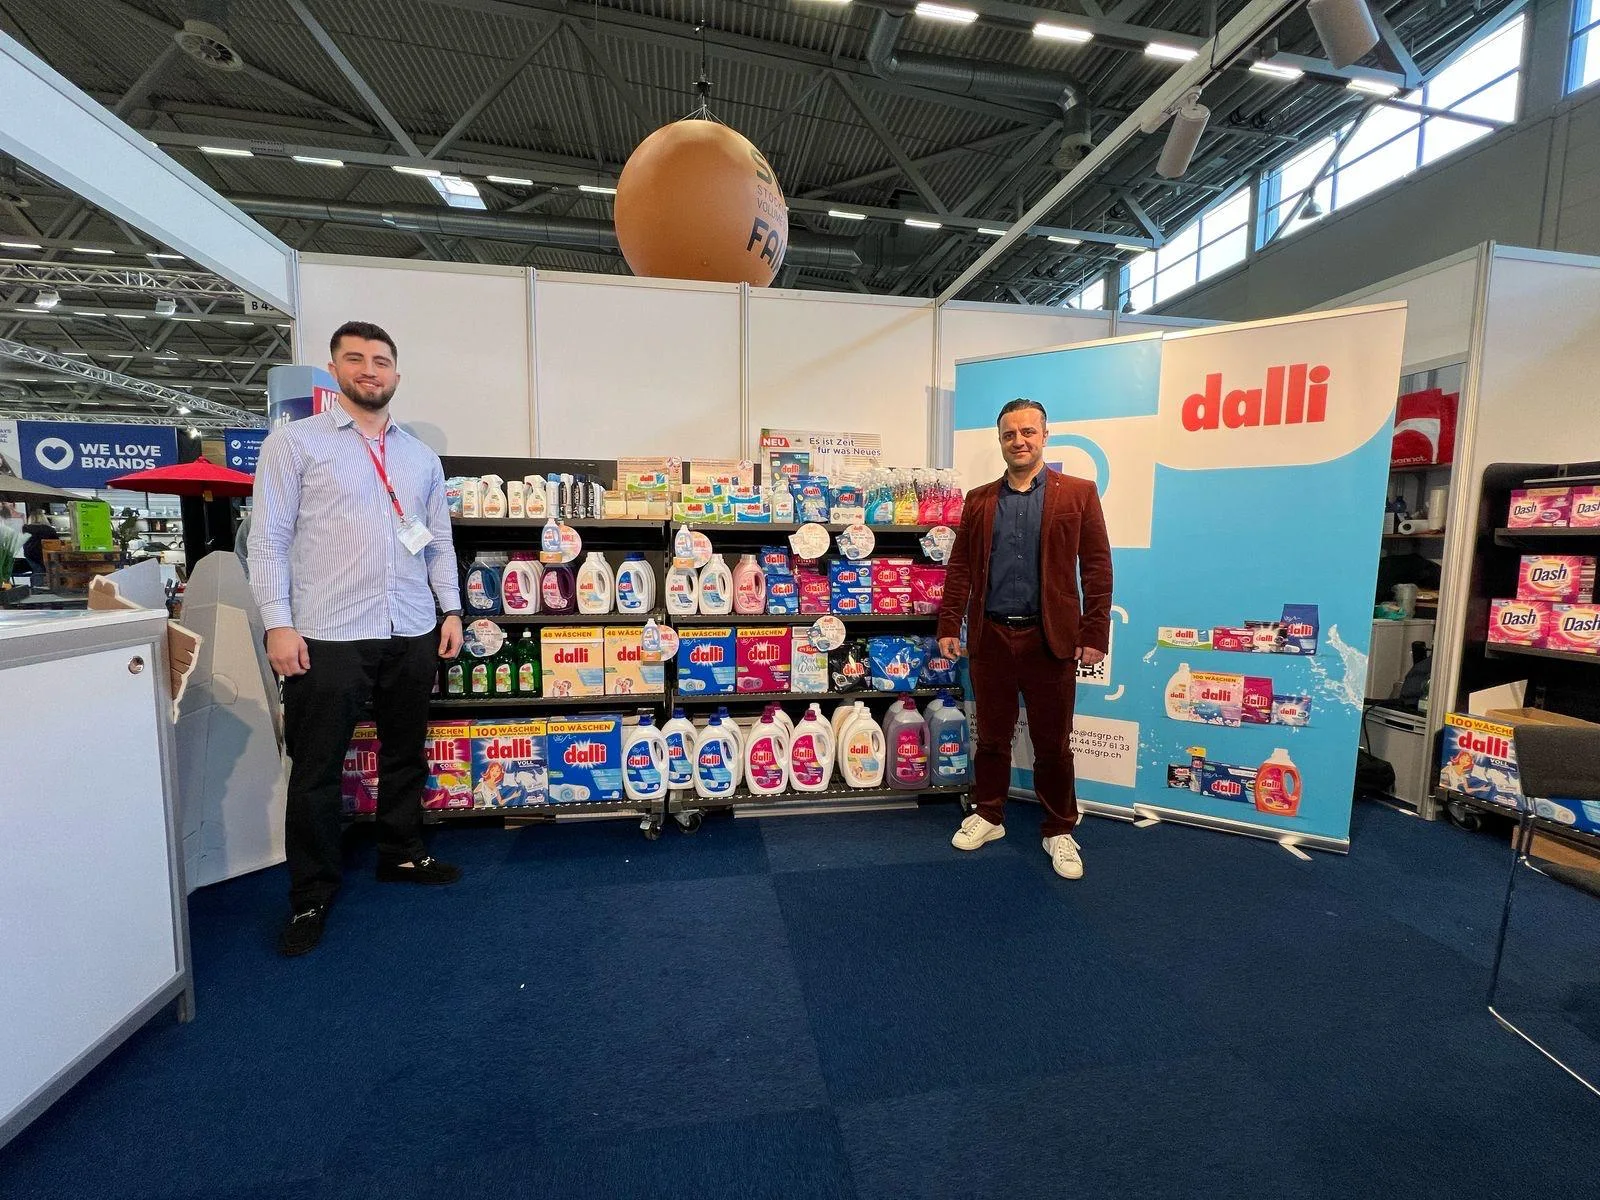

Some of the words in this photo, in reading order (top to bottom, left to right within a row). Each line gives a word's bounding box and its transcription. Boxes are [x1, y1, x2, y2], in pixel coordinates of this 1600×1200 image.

[1181, 363, 1331, 432] dalli
[762, 437, 786, 447] NEU
[809, 437, 820, 445] Es
[822, 438, 833, 446] ist
[836, 438, 855, 447] Zeit
[79, 443, 110, 456] WE
[115, 444, 161, 457] LOVE
[853, 447, 881, 456] Neues
[81, 457, 156, 470] BRANDS
[781, 463, 800, 474] dalli
[696, 486, 711, 494] dalli
[803, 487, 820, 496] dalli
[688, 504, 702, 512] dalli
[1514, 502, 1537, 515] Dash
[765, 554, 785, 564] dalli
[838, 572, 857, 582] dalli
[878, 571, 897, 581] dalli
[1531, 564, 1567, 582] Dash
[468, 582, 482, 590] dalli
[504, 582, 519, 590] dalli
[543, 582, 557, 590] dalli
[580, 582, 594, 590] dalli
[618, 582, 632, 590] dalli
[670, 584, 684, 592] dalli
[739, 584, 752, 592] dalli
[772, 583, 794, 594] dalli
[805, 583, 827, 593] dalli
[927, 586, 945, 599] dall
[838, 598, 857, 609] dalli
[879, 598, 897, 608] dalli
[1501, 609, 1537, 626] Dash
[1564, 613, 1600, 631] Dash
[555, 630, 592, 638] WÄSCHEN
[692, 629, 727, 637] WÄSCHEN
[1175, 631, 1194, 639] dalli
[1287, 624, 1313, 636] dalli
[1220, 638, 1238, 648] dalli
[554, 648, 589, 664] dalli
[617, 646, 642, 661] dal
[690, 646, 724, 663] dalli
[748, 644, 780, 661] dalli
[843, 663, 864, 675] dalli
[928, 659, 949, 670] dalli
[1204, 675, 1236, 683] WÄSCHEN
[1201, 688, 1231, 702] dalli
[1243, 695, 1268, 706] dalli
[1280, 708, 1297, 716] dalli
[567, 723, 611, 732] WÄSCHEN
[1450, 716, 1472, 729] 100
[427, 727, 464, 736] ÄSCHEN
[476, 727, 498, 737] 100
[499, 725, 541, 734] WÄSCHEN
[1071, 729, 1125, 741] o@dsgrp.ch
[486, 738, 532, 760] dalli
[850, 744, 869, 754] dalli
[898, 744, 918, 755] dalli
[940, 743, 960, 754] dalli
[1092, 740, 1107, 748] 557
[1458, 731, 1510, 759] dalli
[424, 740, 456, 761] alli
[564, 744, 606, 764] dalli
[668, 747, 682, 757] alli
[752, 750, 772, 762] dalli
[794, 748, 814, 758] dalli
[1069, 746, 1122, 759] ww.dsgrp.ch
[343, 751, 377, 772] alli
[628, 755, 649, 766] dalli
[701, 755, 721, 765] dalli
[1489, 758, 1509, 767] VOLL
[1212, 780, 1241, 795] dalli
[1261, 780, 1281, 789] dalli
